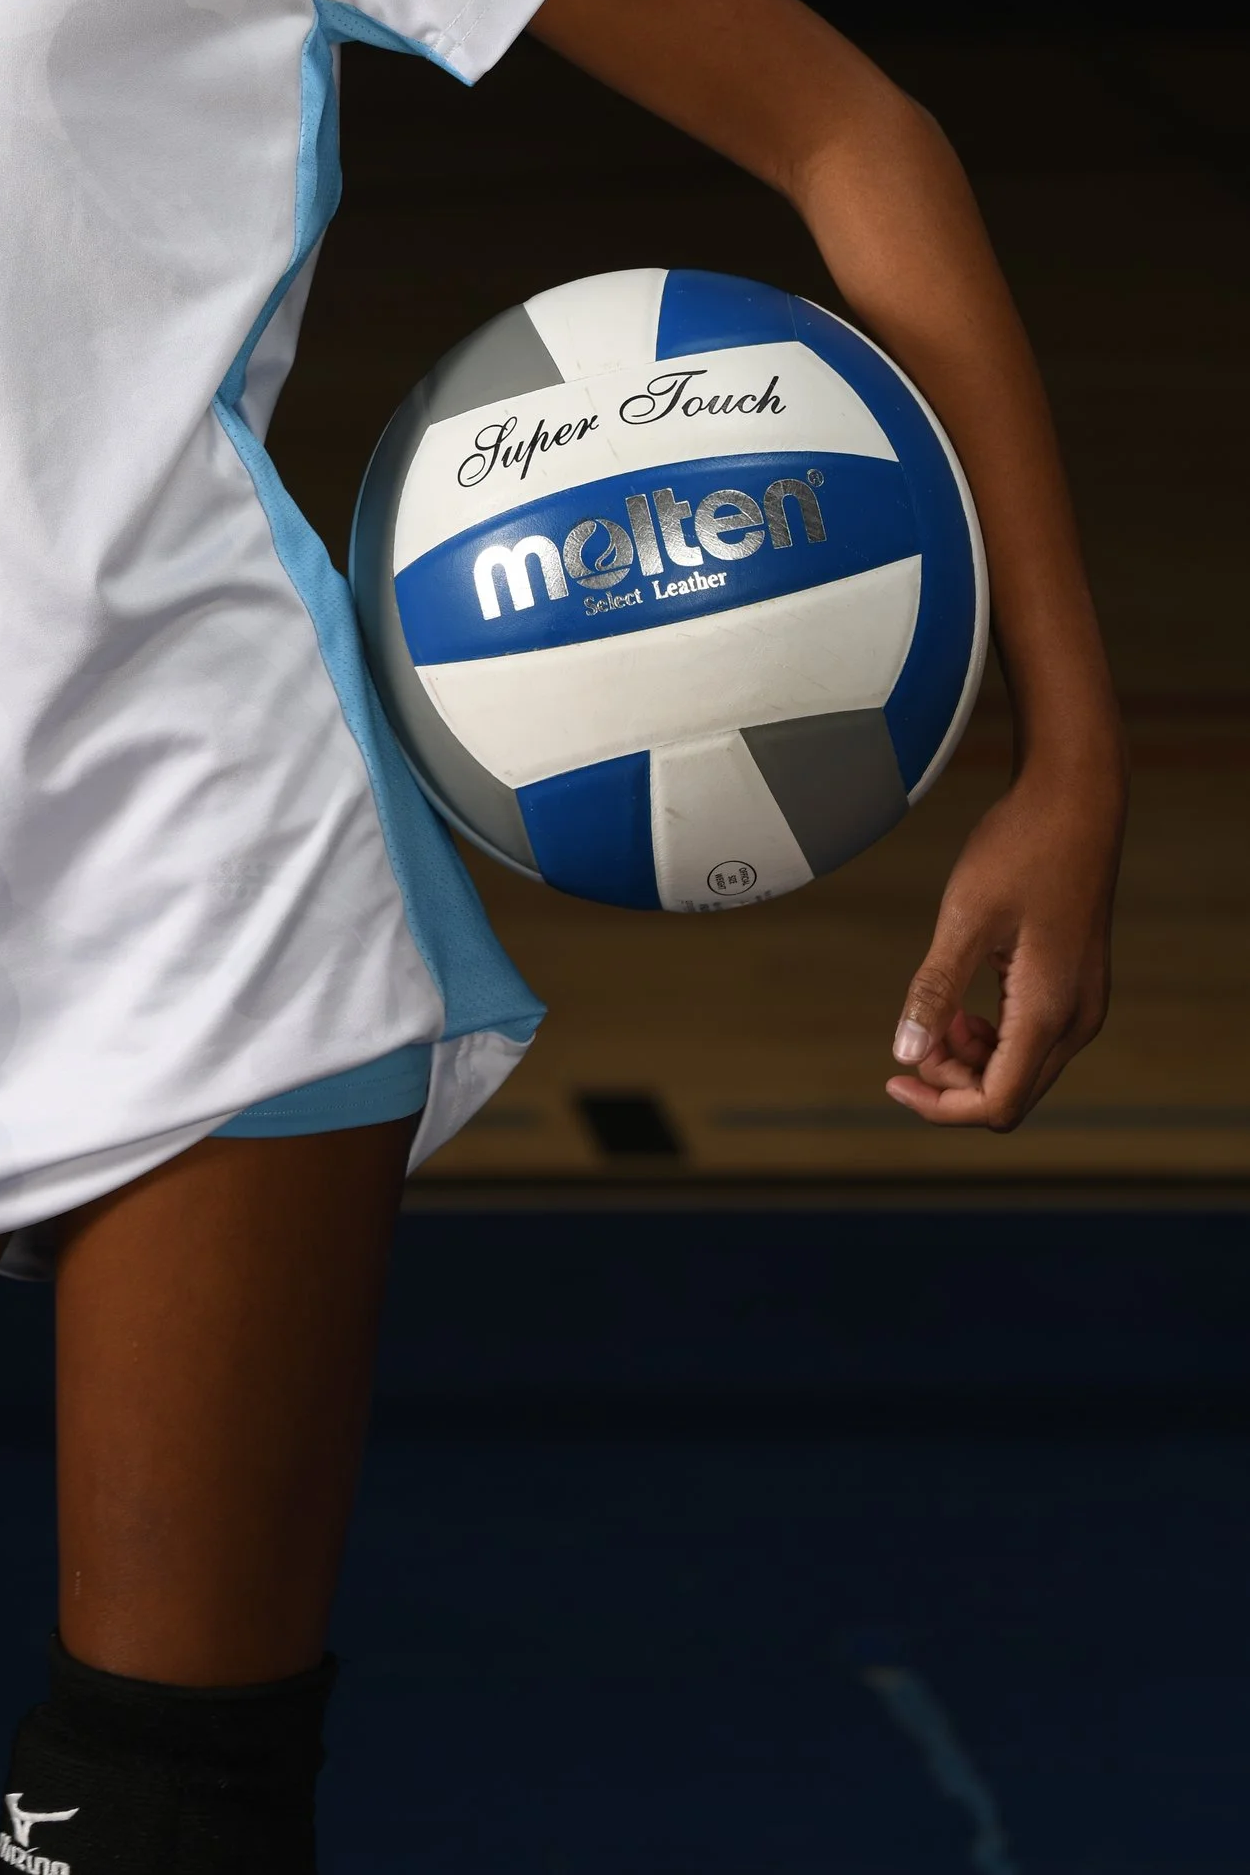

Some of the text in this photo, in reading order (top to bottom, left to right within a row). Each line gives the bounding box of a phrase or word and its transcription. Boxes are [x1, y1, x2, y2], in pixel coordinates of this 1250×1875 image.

[457, 370, 786, 488] Super Touch
[474, 478, 828, 621] molten
[585, 570, 727, 616] Select Leather
[715, 873, 727, 891] WEIGHT
[728, 875, 738, 885] SIZE
[738, 867, 750, 886] OFFICIAL
